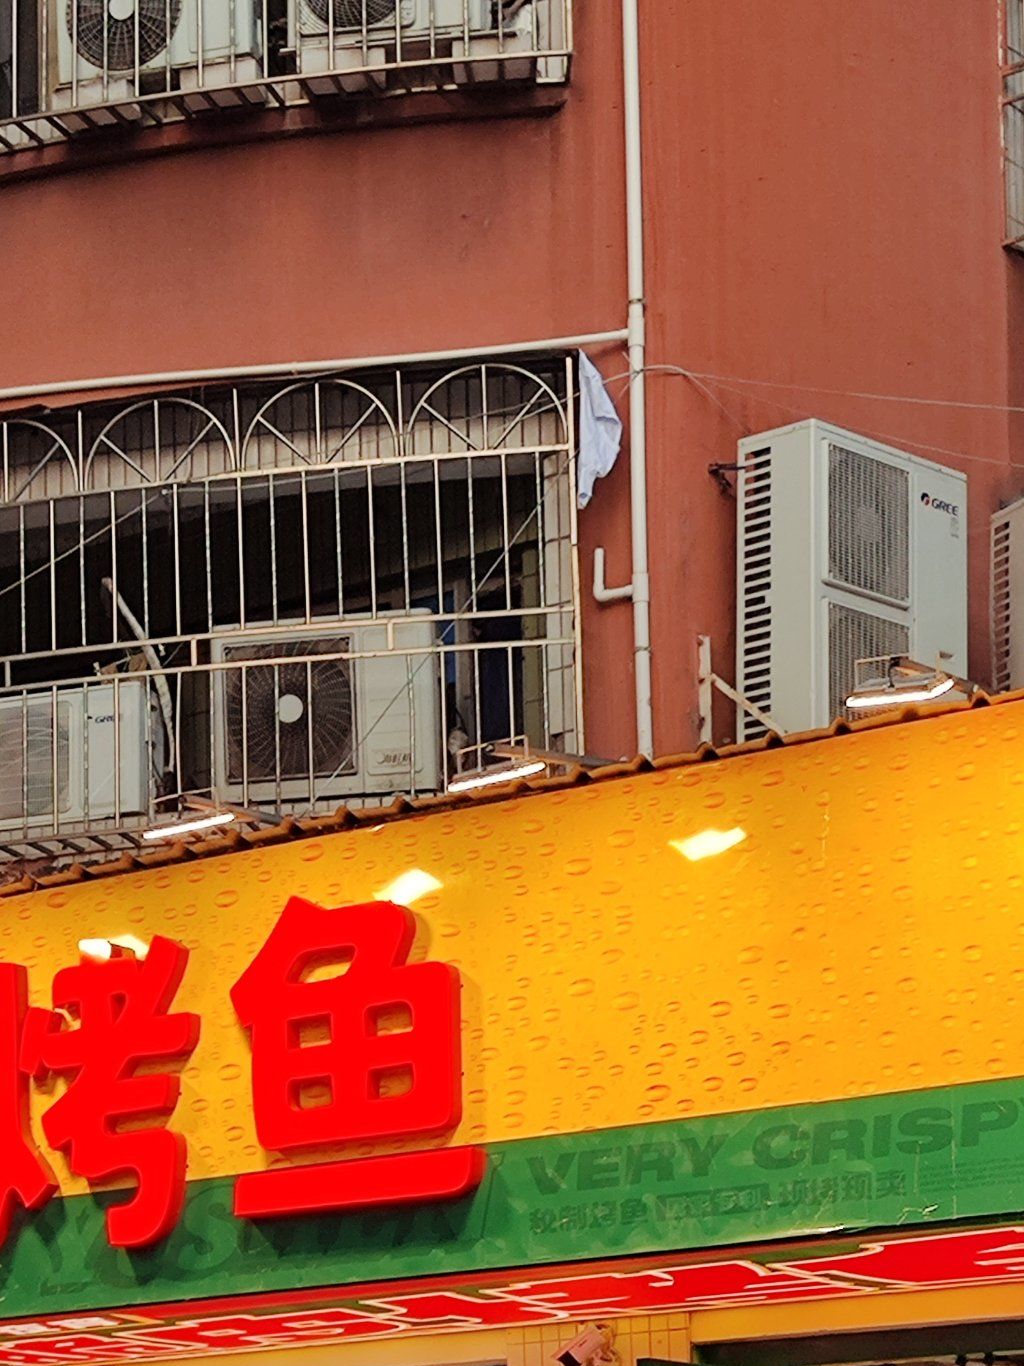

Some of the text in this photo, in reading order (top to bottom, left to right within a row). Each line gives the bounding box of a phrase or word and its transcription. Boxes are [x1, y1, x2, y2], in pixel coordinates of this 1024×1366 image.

[931, 498, 960, 516] GREE
[526, 1133, 729, 1196] VERY
[751, 1096, 1024, 1171] CRISP
